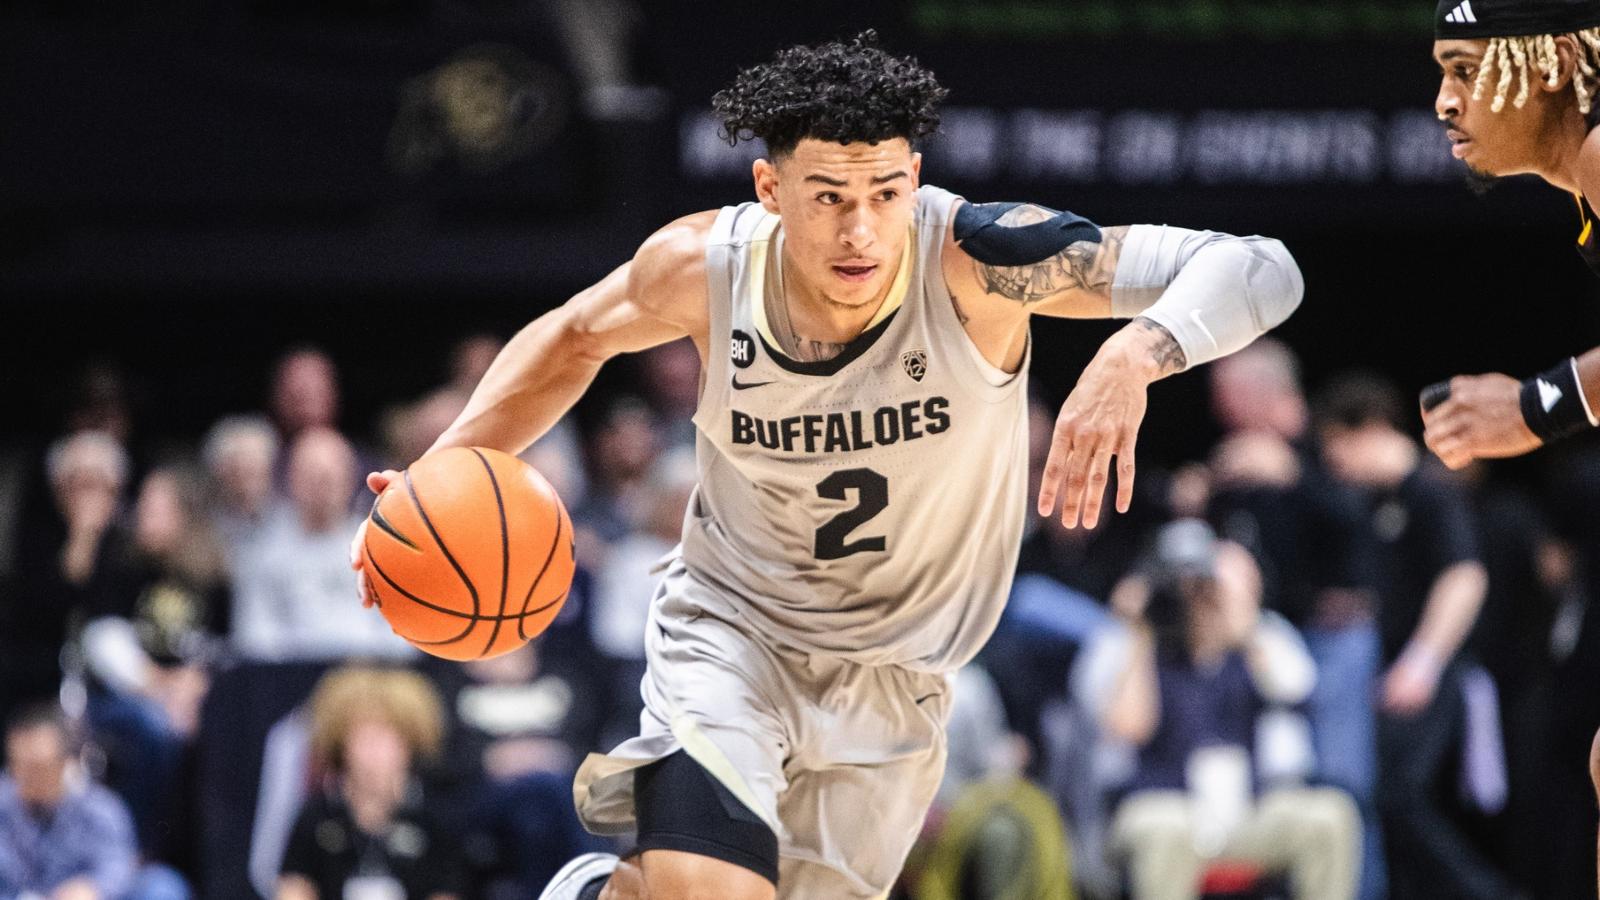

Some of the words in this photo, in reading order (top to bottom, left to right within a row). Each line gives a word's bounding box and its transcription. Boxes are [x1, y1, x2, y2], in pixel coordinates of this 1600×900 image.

[731, 338, 749, 361] BH
[731, 396, 951, 453] BUFFALOES
[814, 467, 889, 560] 2
